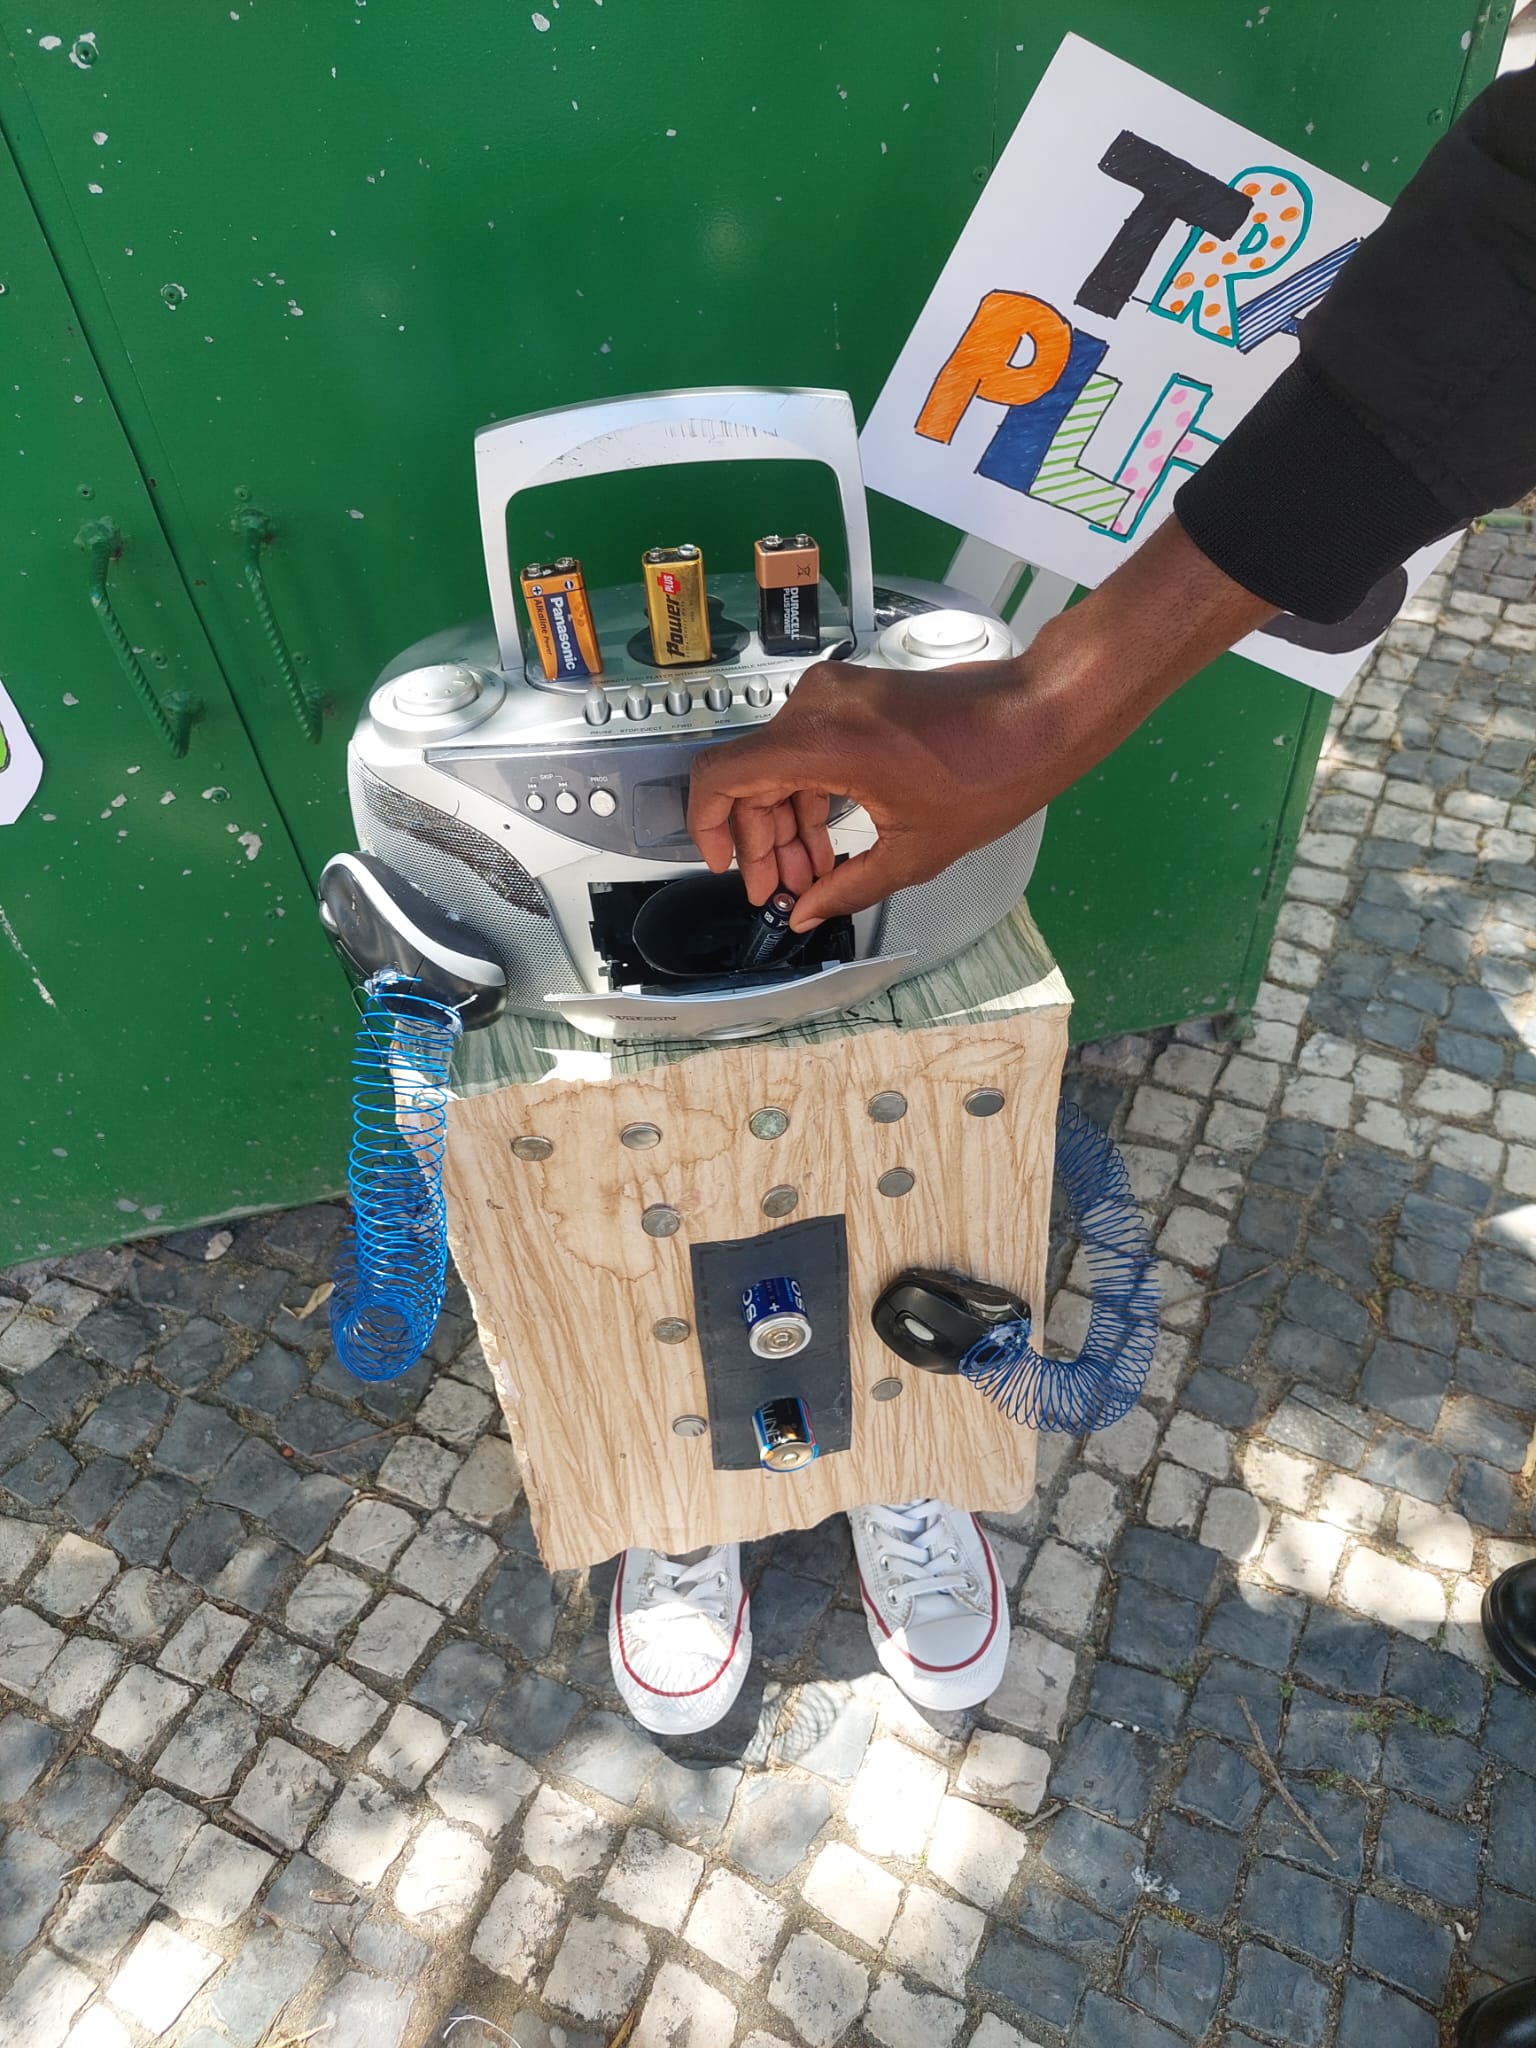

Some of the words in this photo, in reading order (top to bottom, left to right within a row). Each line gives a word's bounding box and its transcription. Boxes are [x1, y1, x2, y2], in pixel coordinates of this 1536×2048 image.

[663, 574, 675, 593] PLUS
[534, 599, 548, 634] Alkaline
[550, 596, 578, 670] Panasonic
[666, 594, 685, 658] Power
[783, 609, 791, 635] POWER
[790, 587, 800, 640] DURACELL
